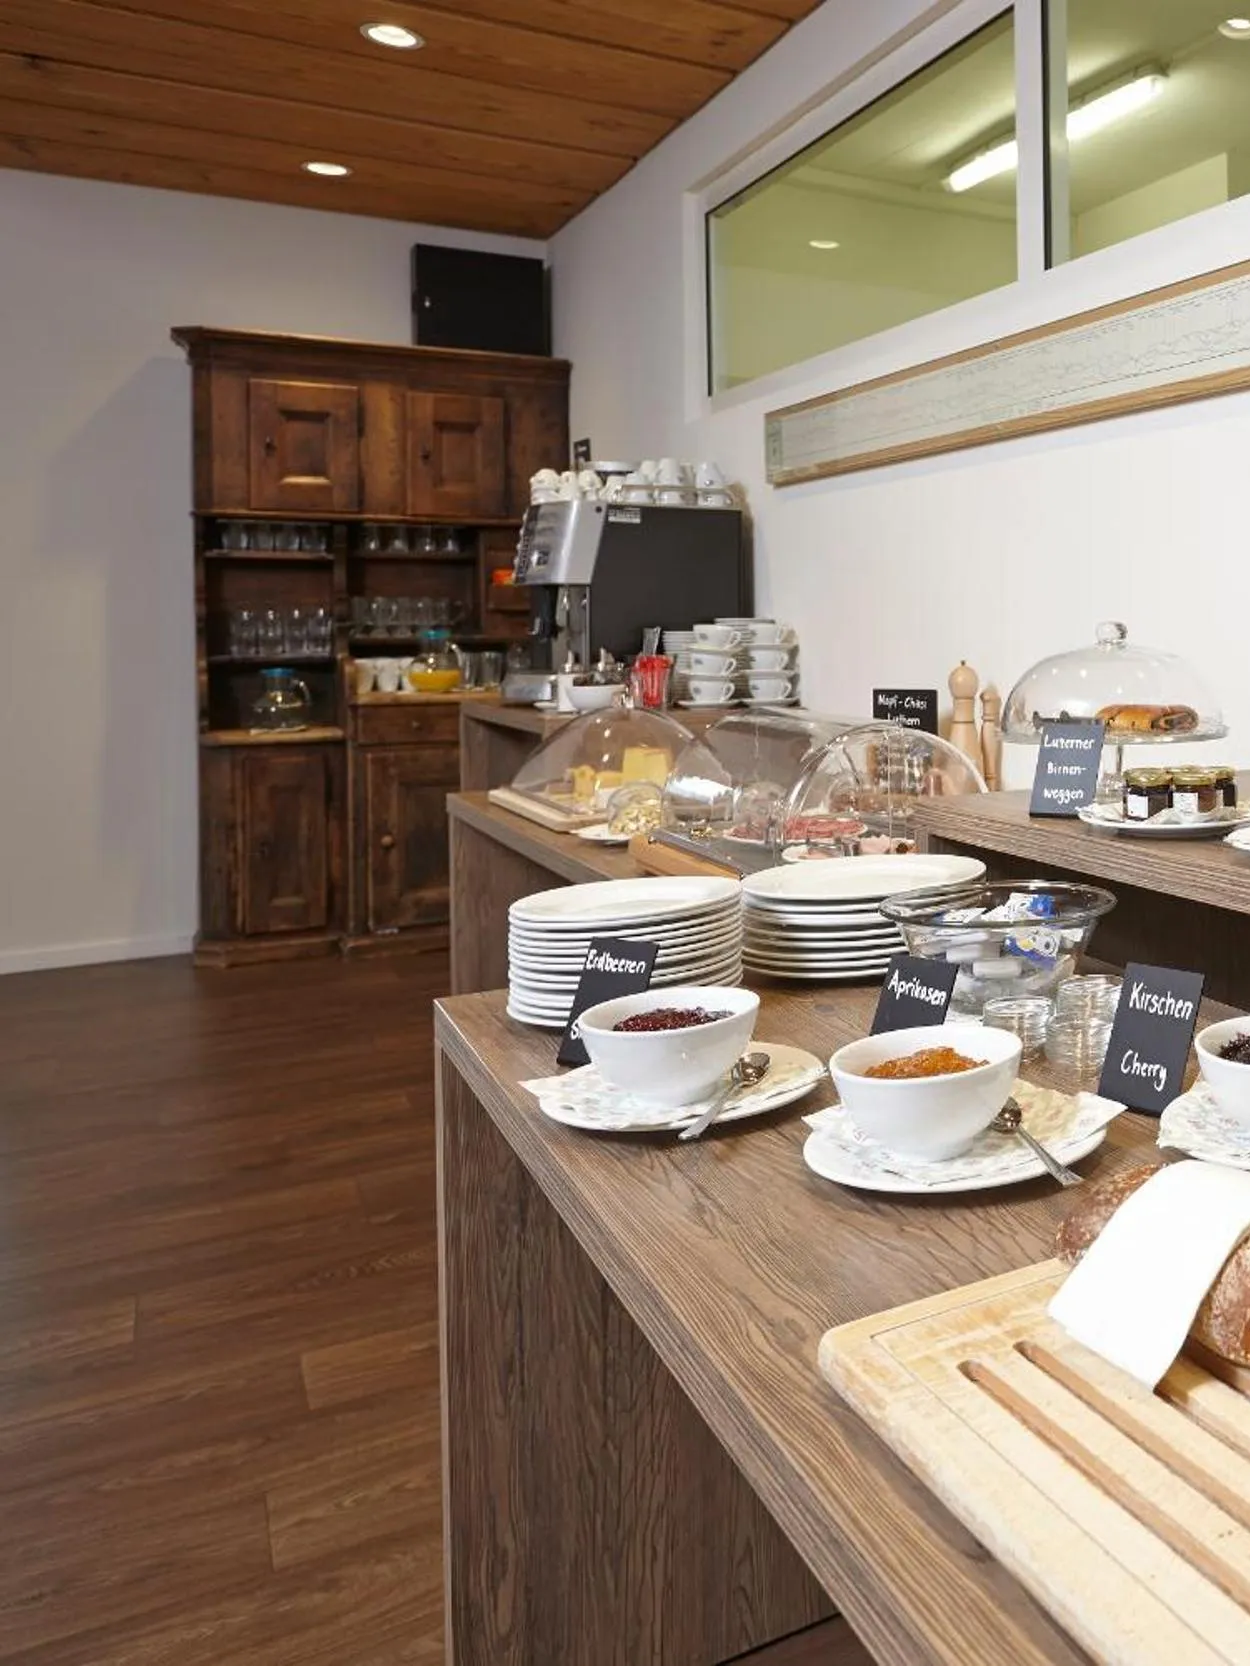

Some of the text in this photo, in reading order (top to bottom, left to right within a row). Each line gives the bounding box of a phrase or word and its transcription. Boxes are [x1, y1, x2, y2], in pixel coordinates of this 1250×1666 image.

[1043, 733, 1095, 750] Luzerner
[585, 948, 647, 974] Erdbeeren
[887, 968, 947, 1006] Aprikosen
[1128, 981, 1194, 1020] Kirschen
[1120, 1049, 1168, 1092] Cherry
